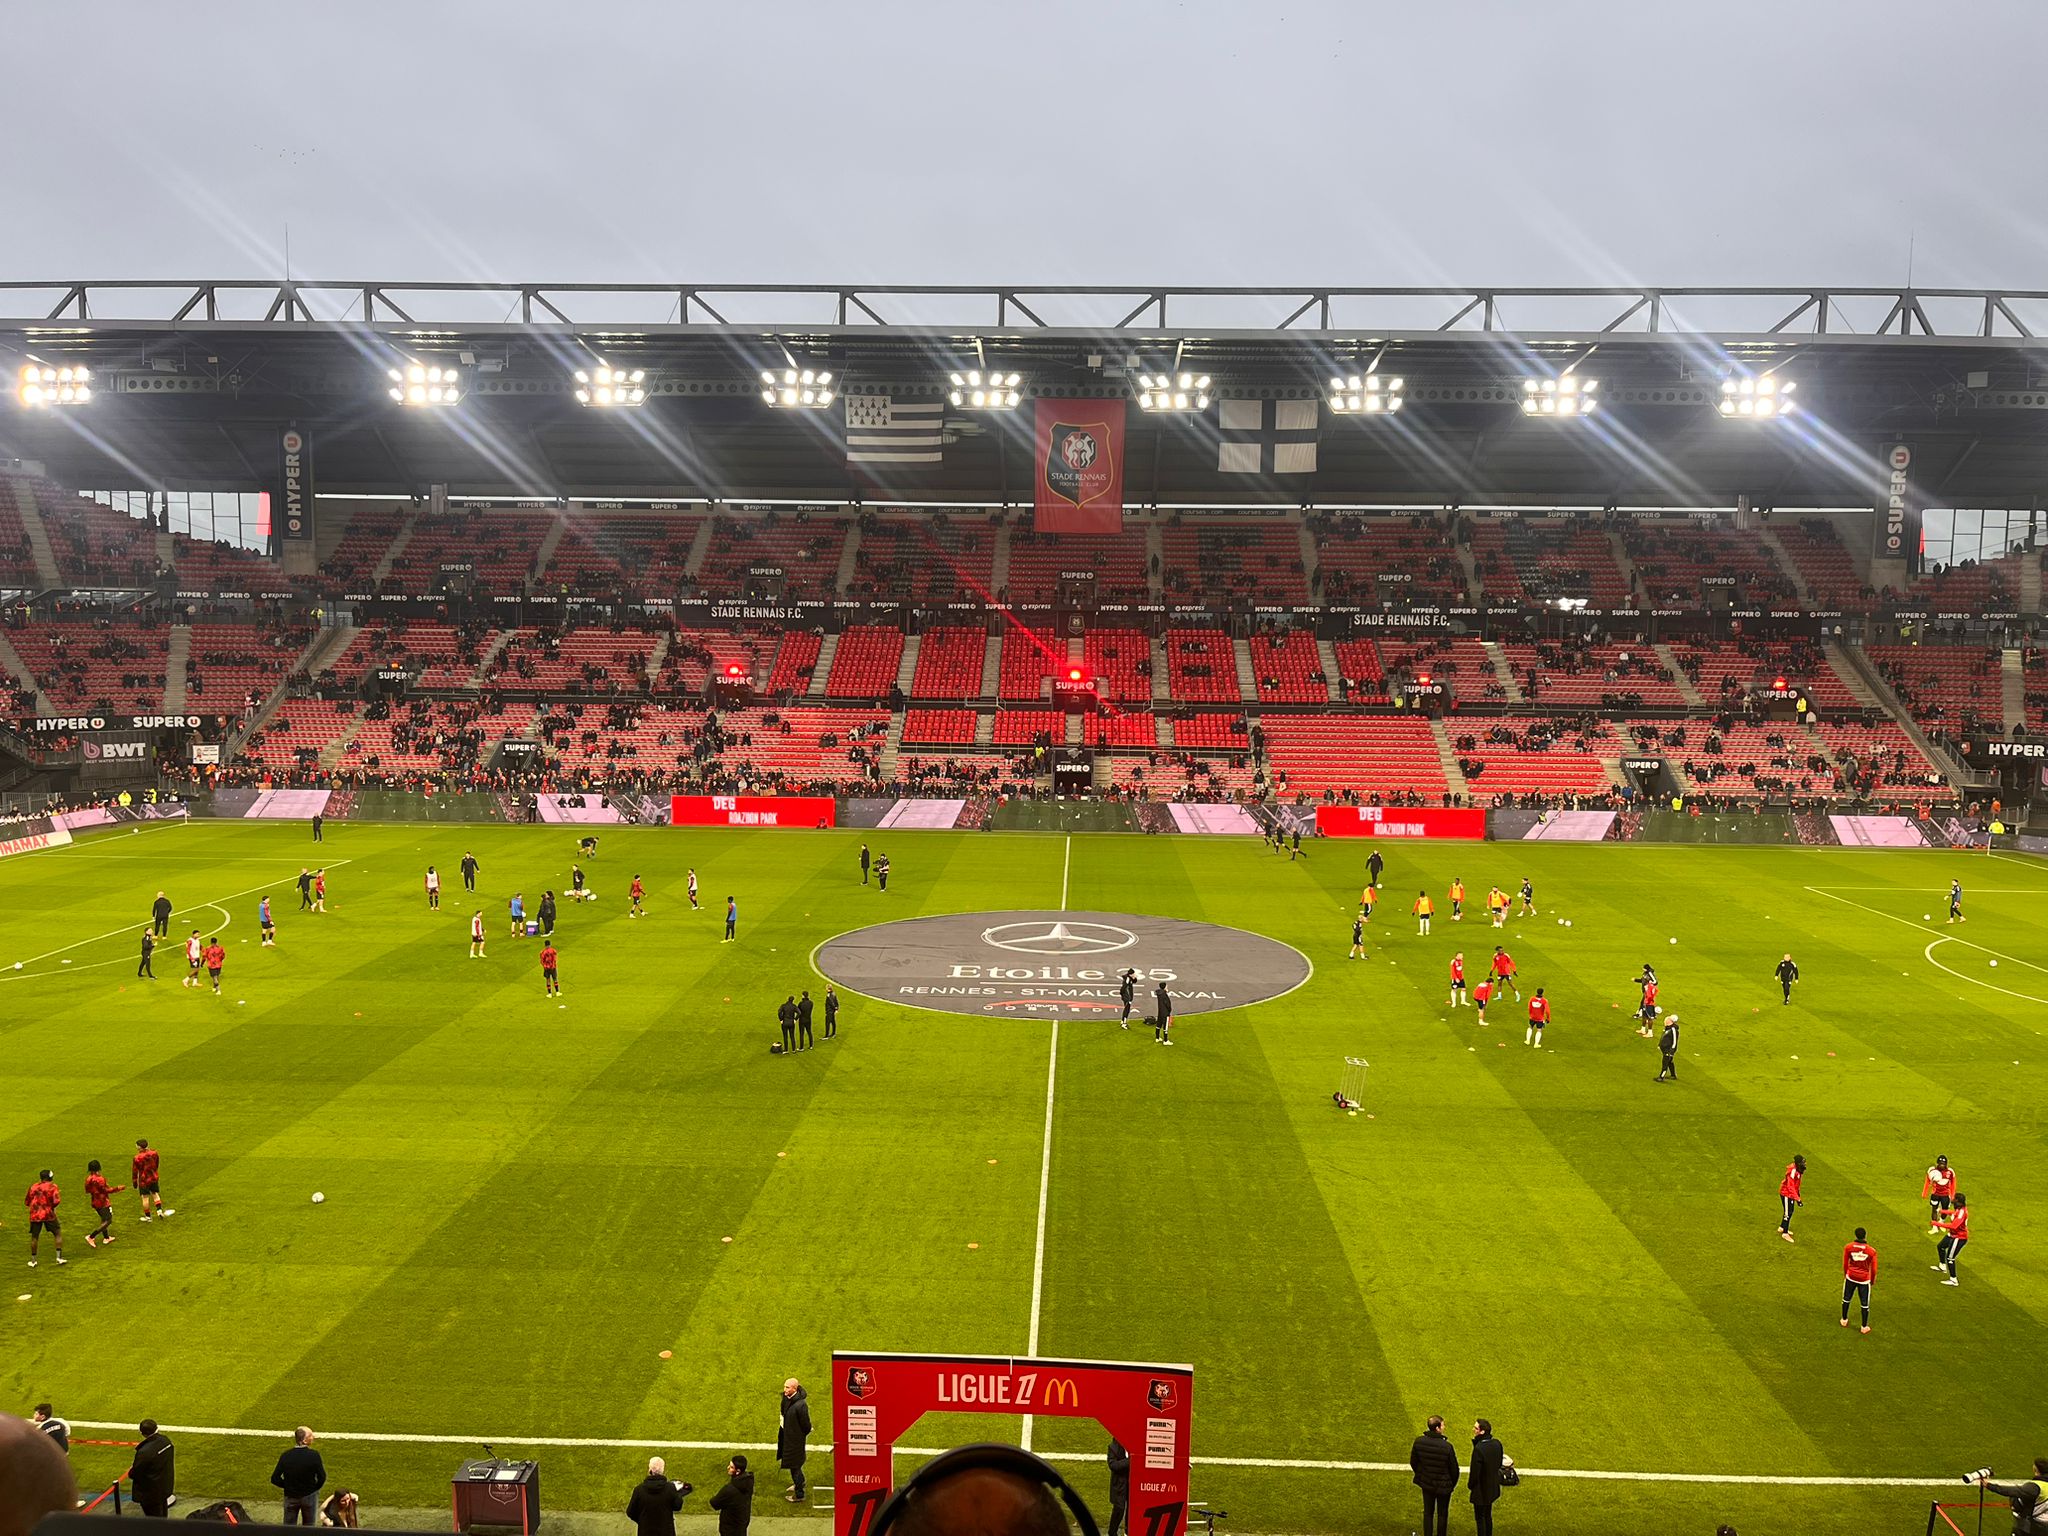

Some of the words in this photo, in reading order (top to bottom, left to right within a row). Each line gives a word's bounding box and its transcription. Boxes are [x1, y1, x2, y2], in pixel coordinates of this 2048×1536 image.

[1051, 472, 1073, 480] STADE
[1075, 473, 1107, 481] RENNAIS
[286, 454, 302, 516] HYPER
[1888, 469, 1907, 534] SUPER
[711, 606, 741, 618] STADE
[743, 606, 786, 619] RENNAIS
[787, 608, 804, 619] F.C.
[1354, 614, 1384, 626] STADE
[1387, 614, 1431, 626] RENNAIS
[1433, 615, 1450, 626] F.C.
[716, 677, 746, 685] SUPER
[1055, 682, 1086, 690] SUPER
[36, 718, 89, 731] HYPER
[133, 716, 185, 728] SUPER
[102, 742, 146, 758] BWT
[1989, 743, 2045, 757] HYPER
[946, 964, 1105, 981] Etoile
[899, 986, 996, 995] RENNES
[938, 1373, 1011, 1404] LIGUE
[844, 1475, 864, 1484] LIGUE
[1140, 1483, 1160, 1492] LIGUE
